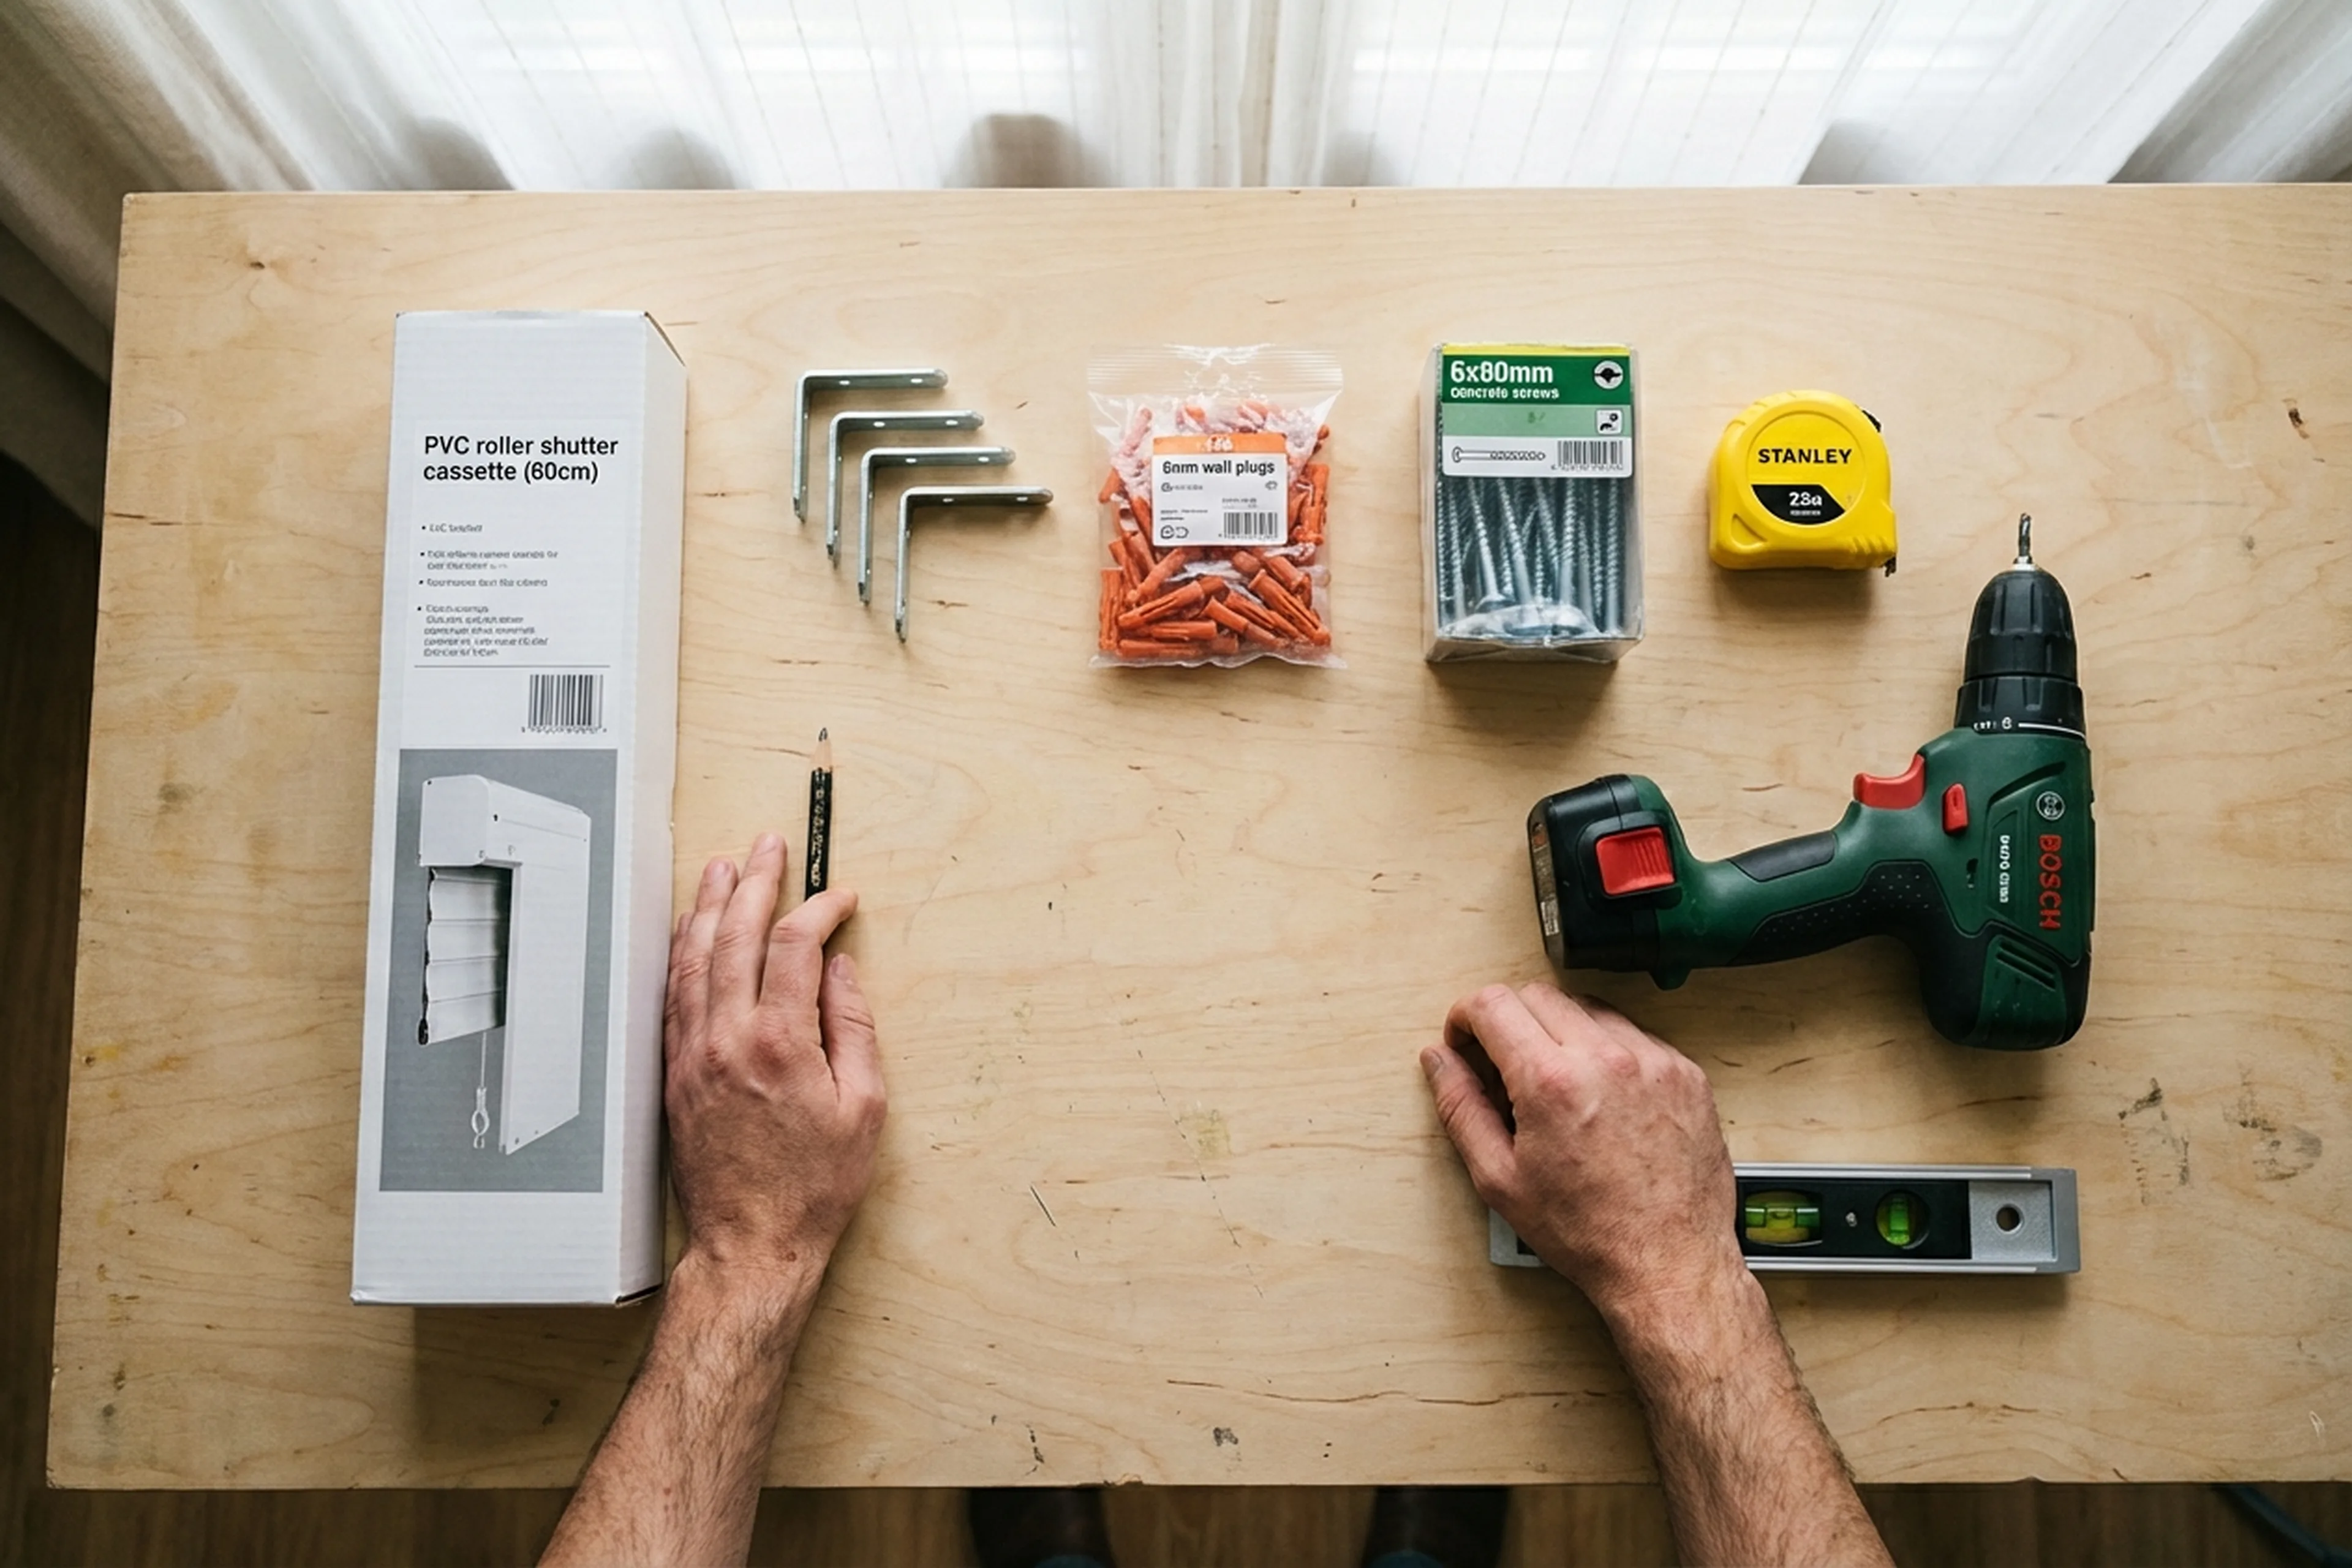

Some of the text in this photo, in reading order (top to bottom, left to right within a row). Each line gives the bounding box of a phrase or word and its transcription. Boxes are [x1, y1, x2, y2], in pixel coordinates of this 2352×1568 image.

[1450, 360, 1554, 383] 6x80mm
[1512, 387, 1560, 399] screws
[424, 435, 619, 456] PVC roller shutter
[1757, 448, 1852, 464] STANLEY
[423, 461, 599, 485] cassette (60cm)
[1201, 460, 1232, 475] wall
[1235, 460, 1275, 477] plugs
[2038, 834, 2063, 930] BOSCH
